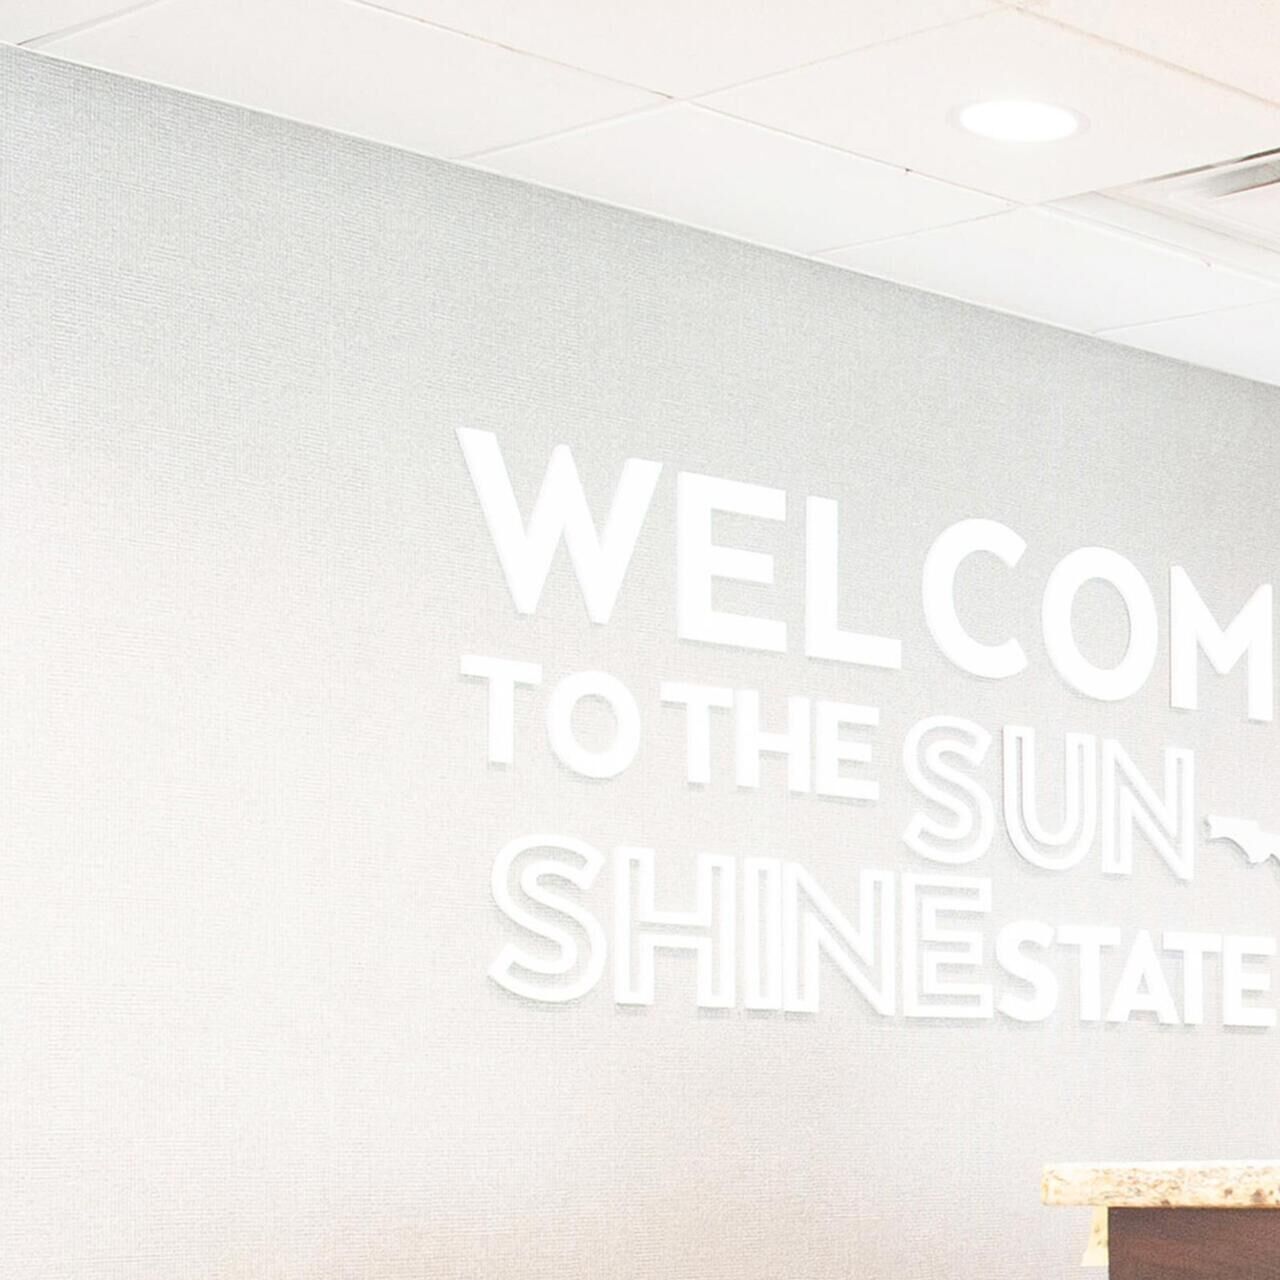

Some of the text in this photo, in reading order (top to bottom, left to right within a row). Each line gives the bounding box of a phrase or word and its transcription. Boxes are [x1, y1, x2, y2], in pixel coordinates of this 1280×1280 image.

[460, 655, 1196, 882] TO THE SUN
[487, 833, 1277, 1027] SHINE STATE
